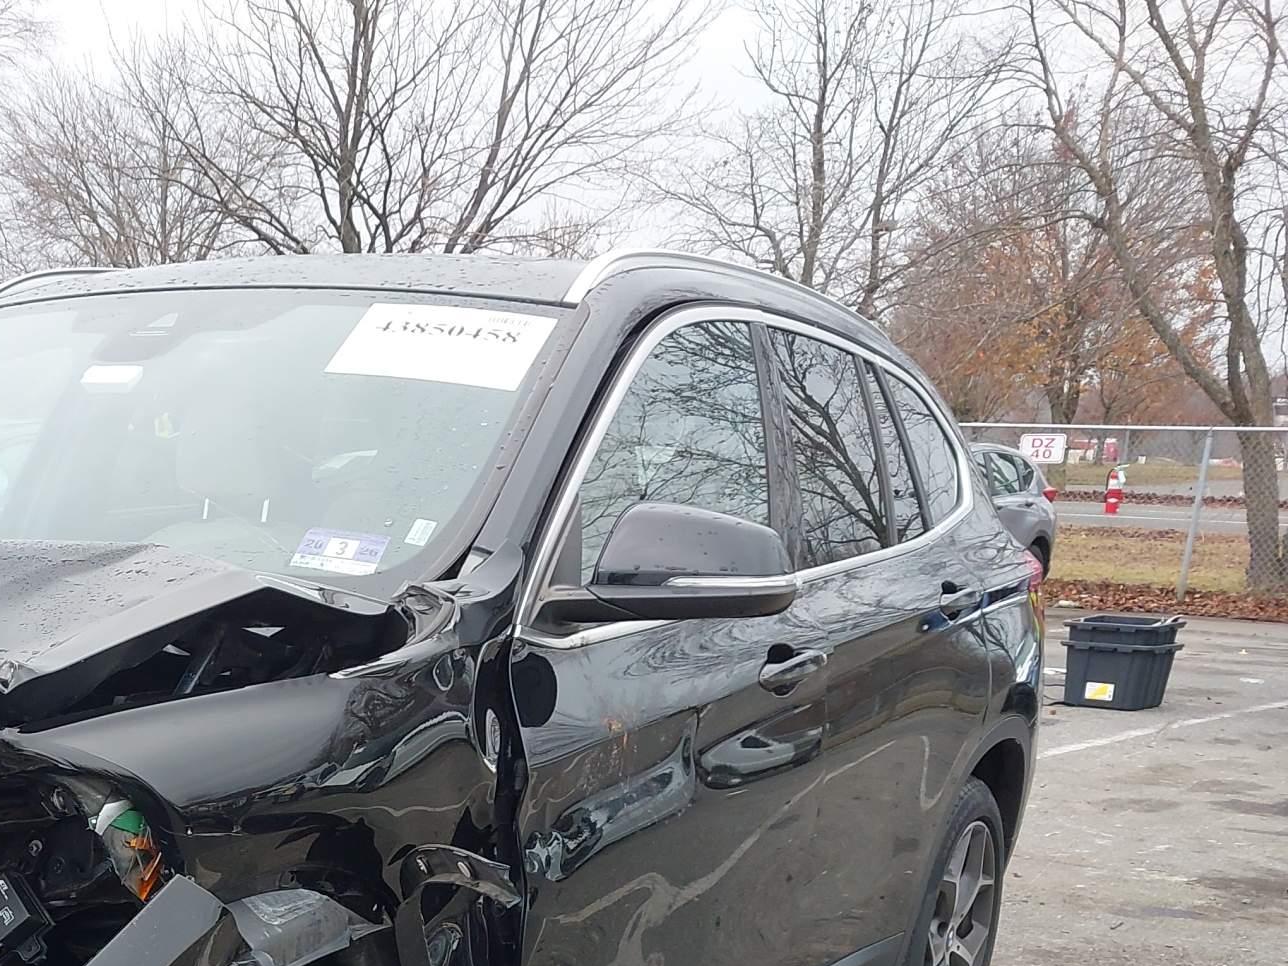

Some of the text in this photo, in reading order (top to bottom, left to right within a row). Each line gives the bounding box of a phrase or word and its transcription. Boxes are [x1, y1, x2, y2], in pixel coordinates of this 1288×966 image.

[376, 320, 521, 343] 43850458
[1031, 437, 1056, 449] DZ
[1031, 449, 1052, 459] 40
[335, 540, 349, 556] 3
